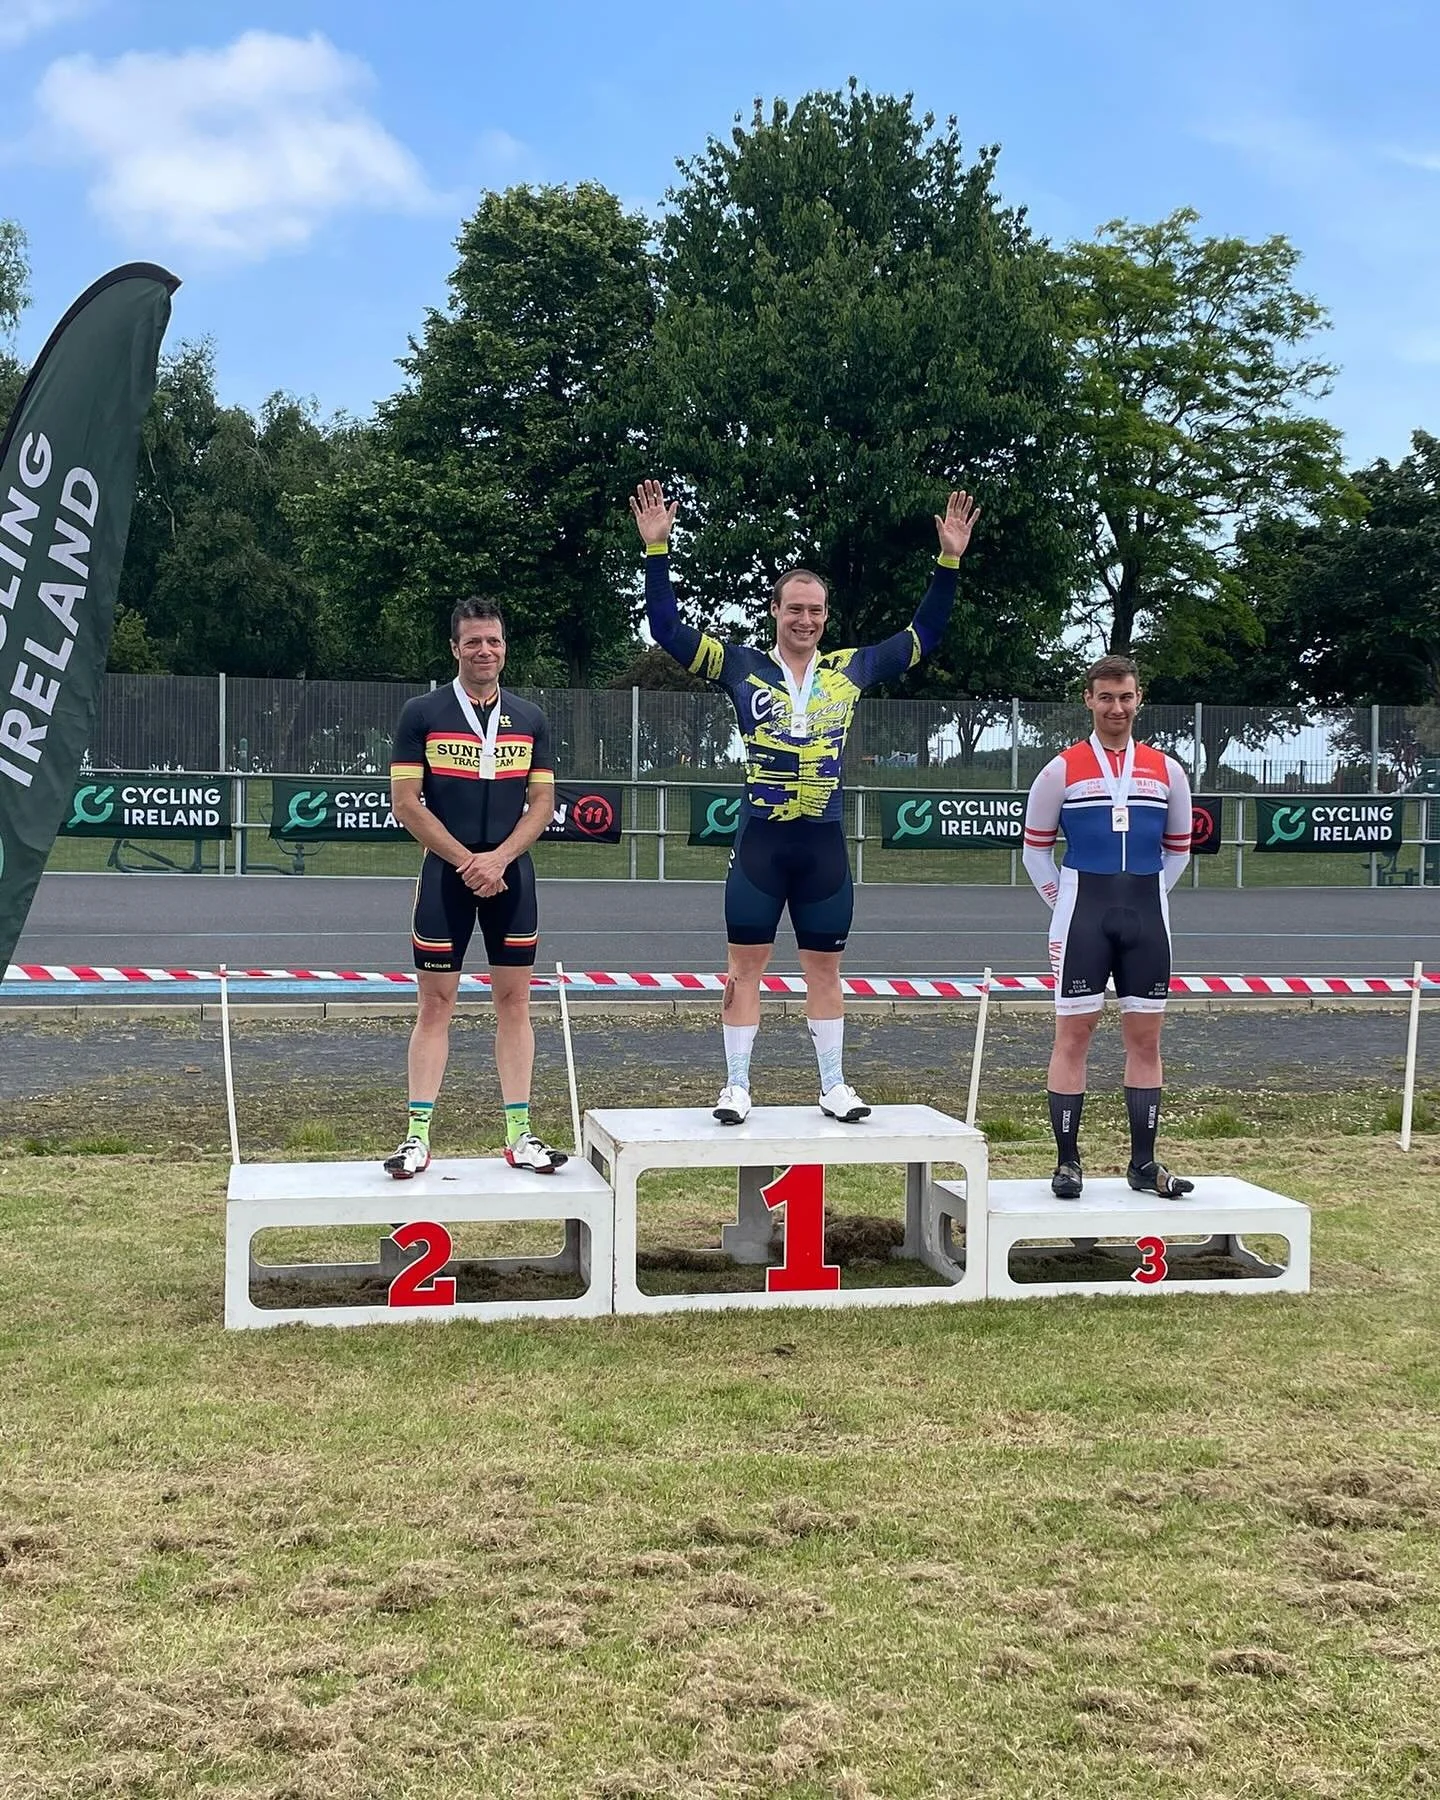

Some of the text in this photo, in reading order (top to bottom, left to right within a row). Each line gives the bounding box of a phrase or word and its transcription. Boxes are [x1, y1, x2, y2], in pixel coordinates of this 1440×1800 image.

[0, 431, 53, 650] LING
[0, 466, 100, 787] IRELAND
[453, 757, 514, 768] TRAC EAM
[121, 786, 221, 805] CYCLING
[123, 808, 220, 827] IRELAND
[938, 800, 1023, 817] CYCLING
[1311, 806, 1394, 822] CYCLING
[336, 812, 404, 828] IRELA
[941, 820, 1022, 837] IRELAND
[1313, 826, 1393, 842] IRELAND
[759, 1164, 841, 1292] 1
[388, 1221, 457, 1308] 2
[1130, 1235, 1168, 1284] 3
